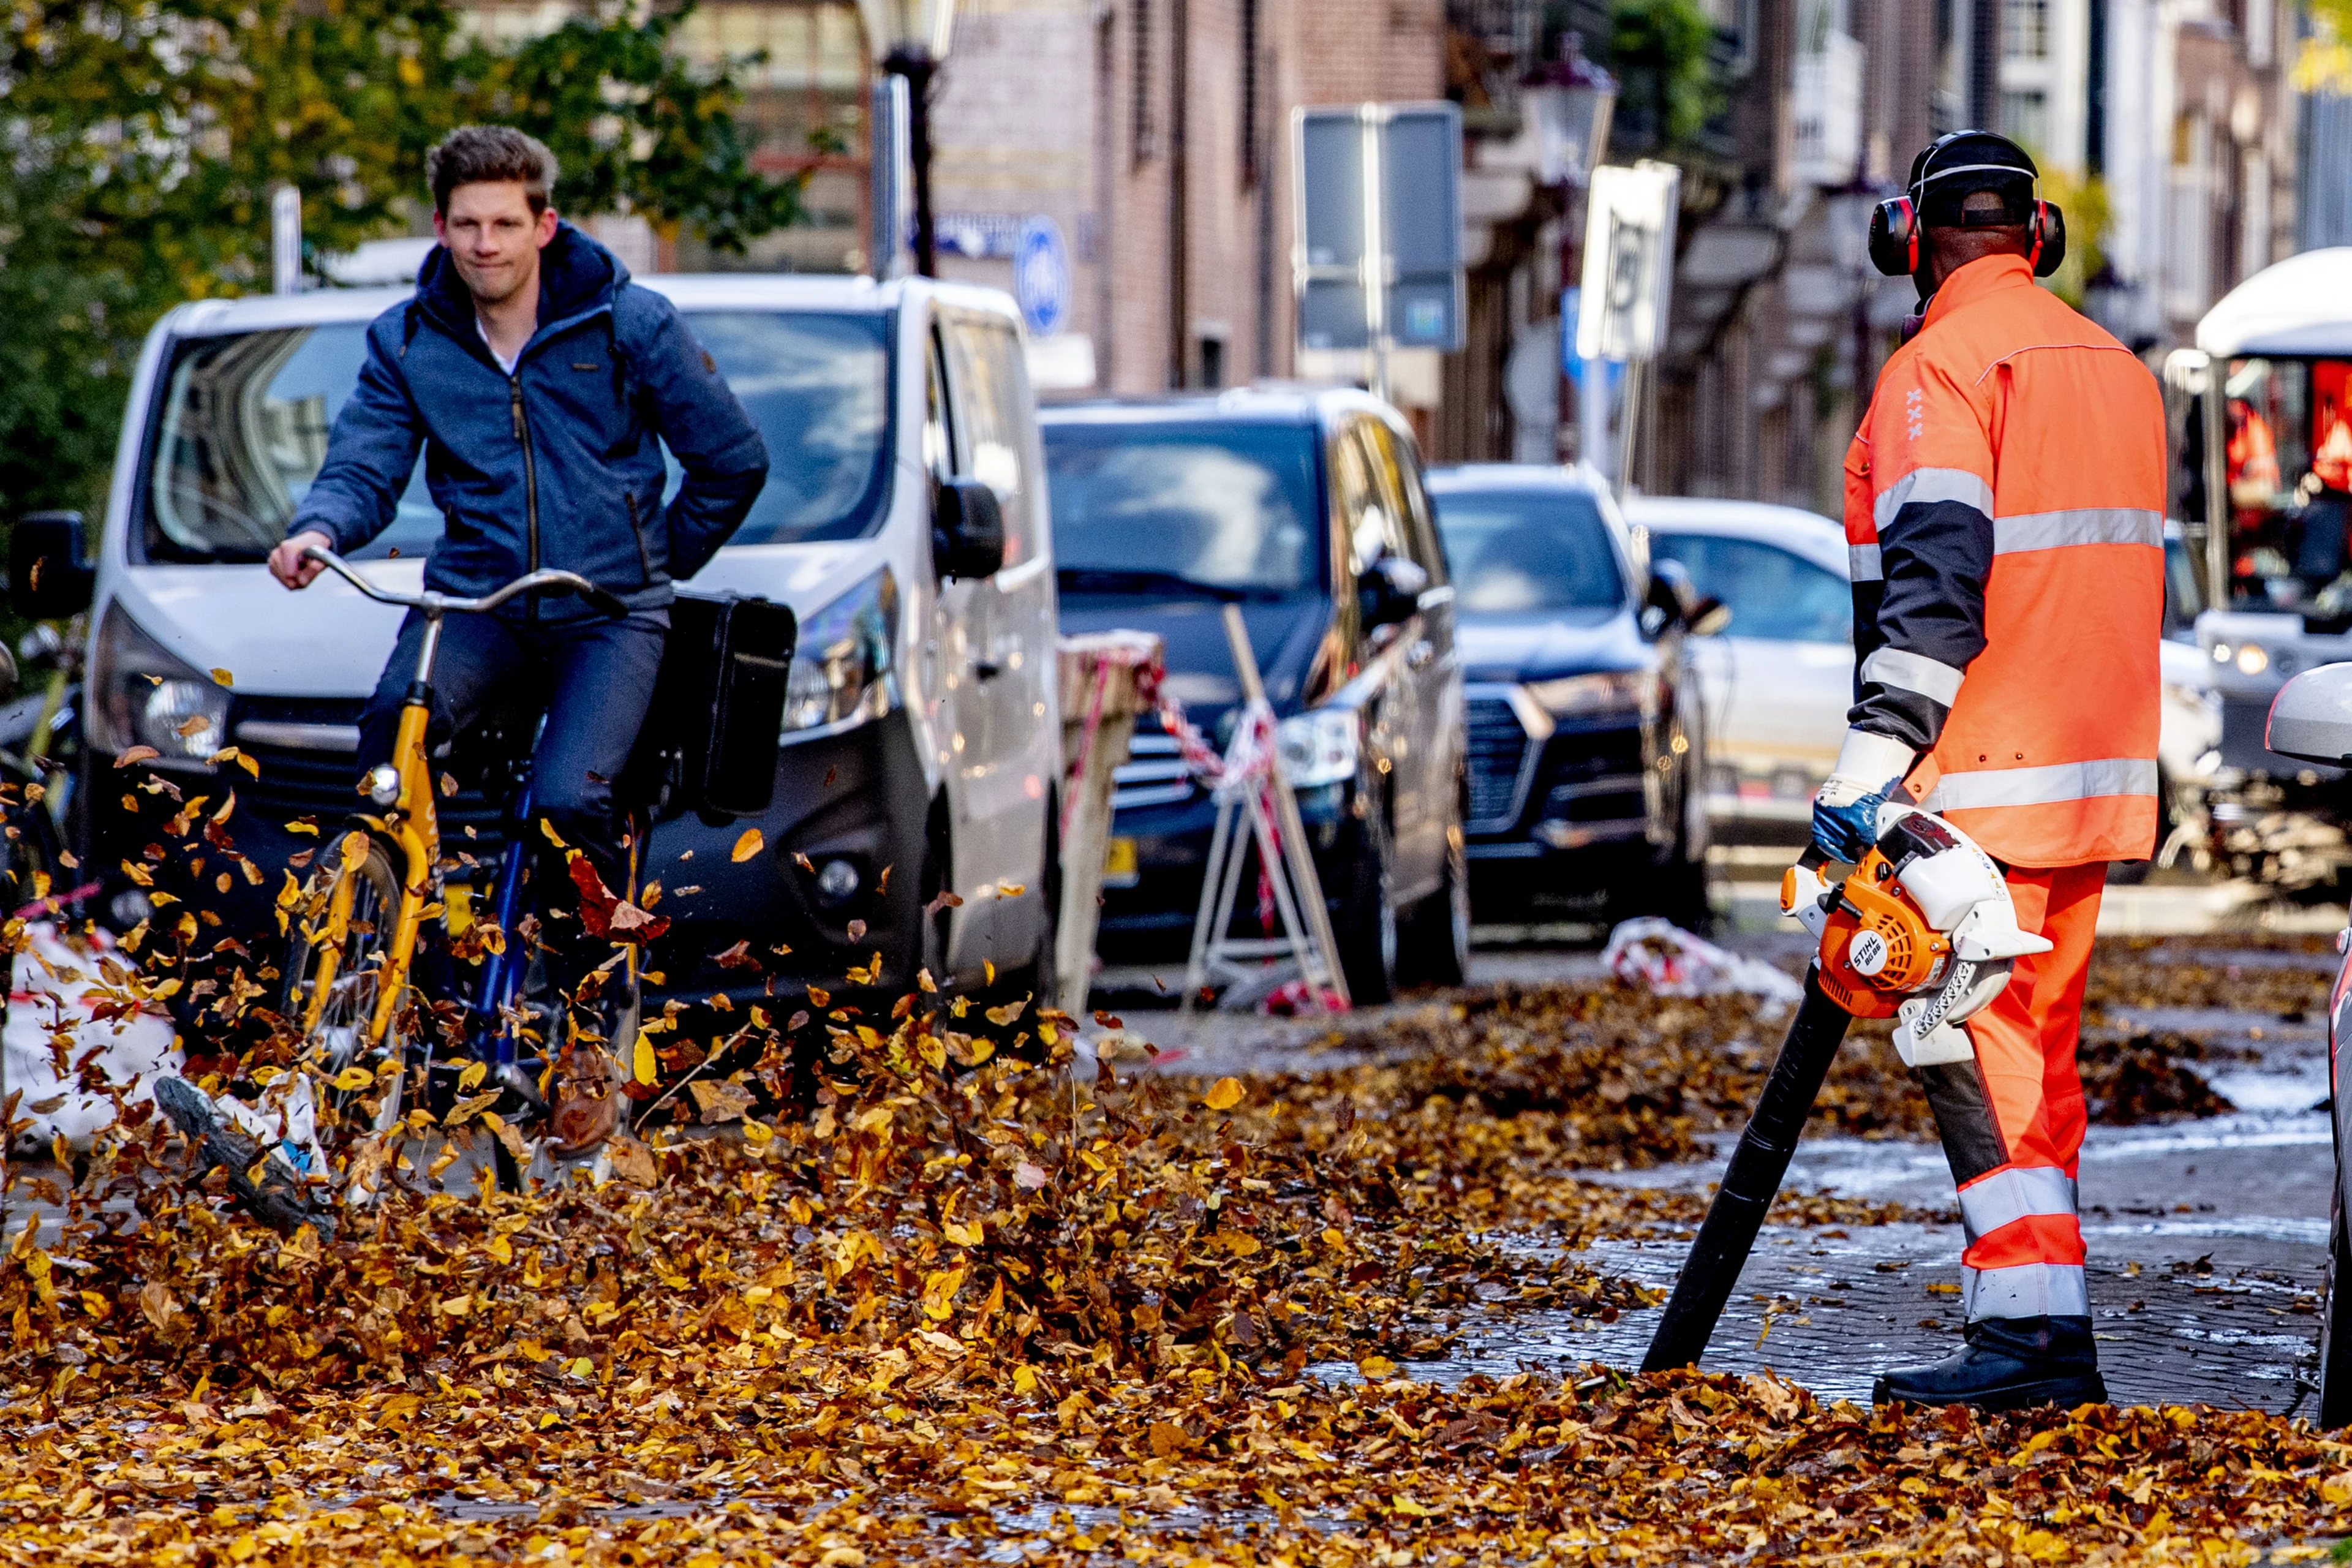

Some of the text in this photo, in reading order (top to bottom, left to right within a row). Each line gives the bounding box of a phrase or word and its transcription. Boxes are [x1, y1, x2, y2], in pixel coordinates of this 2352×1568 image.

[1854, 937, 1877, 967] STIHL
[1864, 943, 1881, 966] BG 86
